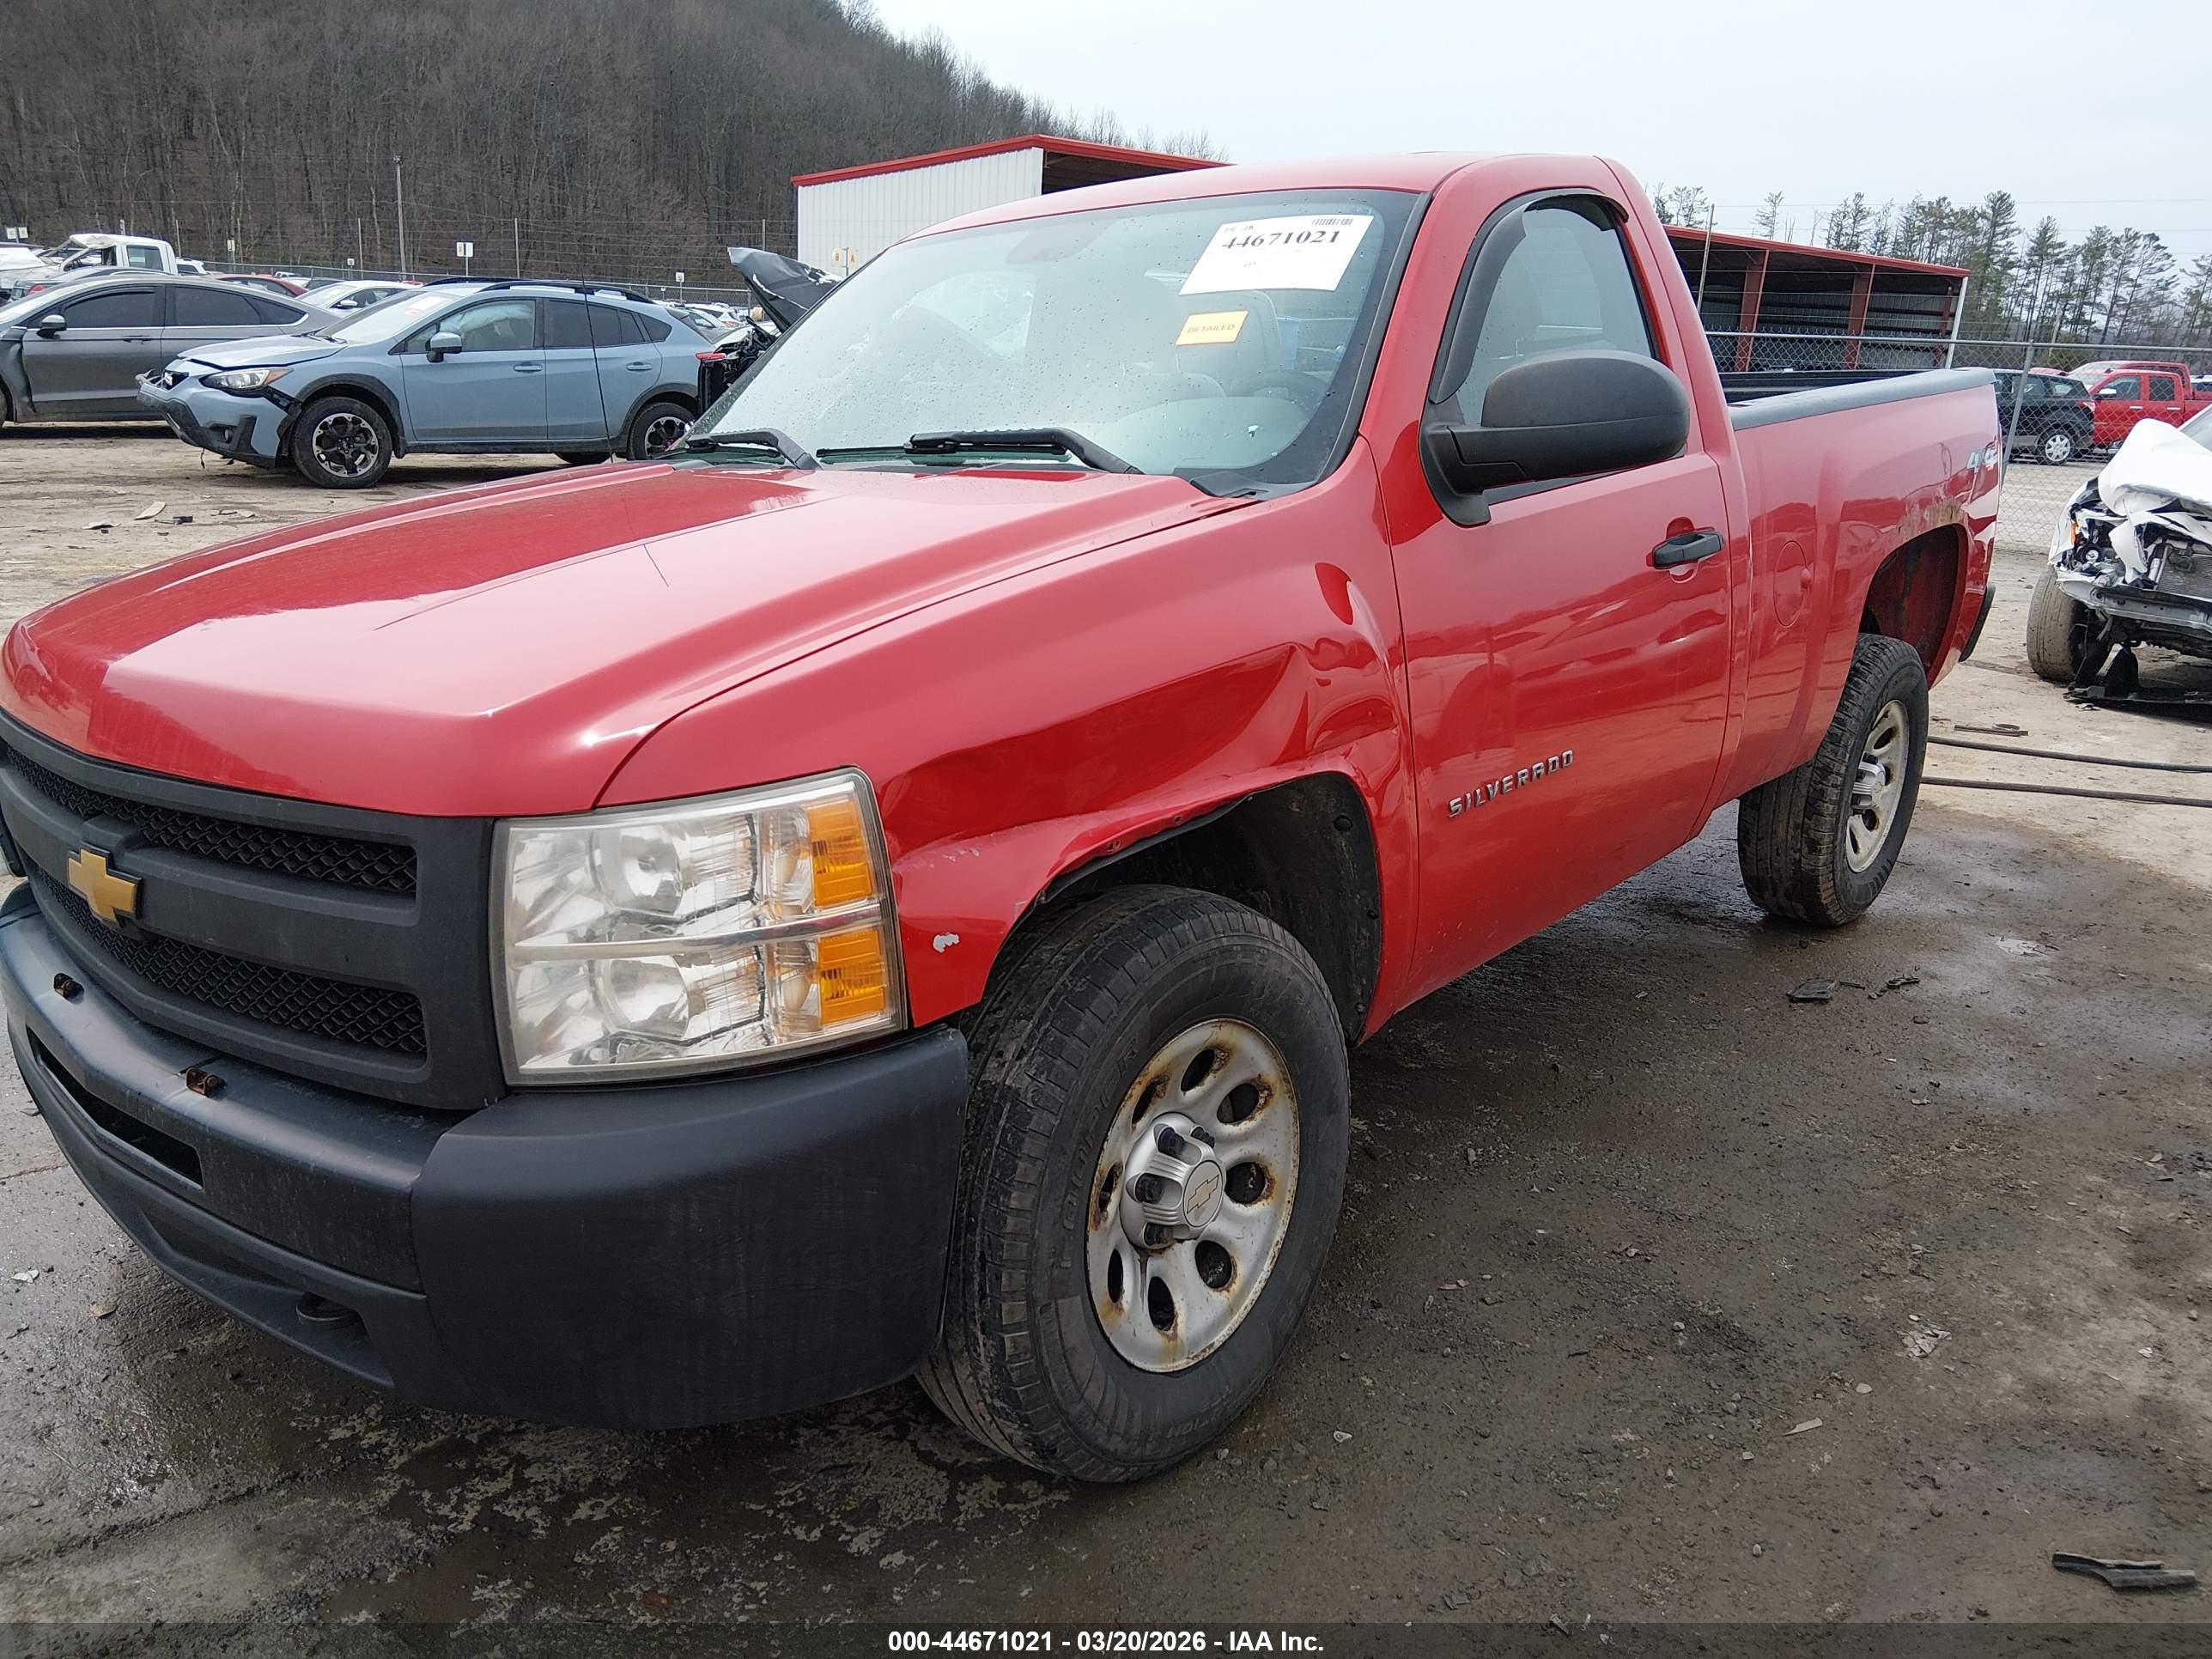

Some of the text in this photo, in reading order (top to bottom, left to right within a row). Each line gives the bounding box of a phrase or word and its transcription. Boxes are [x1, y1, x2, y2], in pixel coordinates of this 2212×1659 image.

[1222, 229, 1340, 249] 44671021
[1187, 323, 1236, 333] DETAILED
[1448, 749, 1575, 818] SILVERADO
